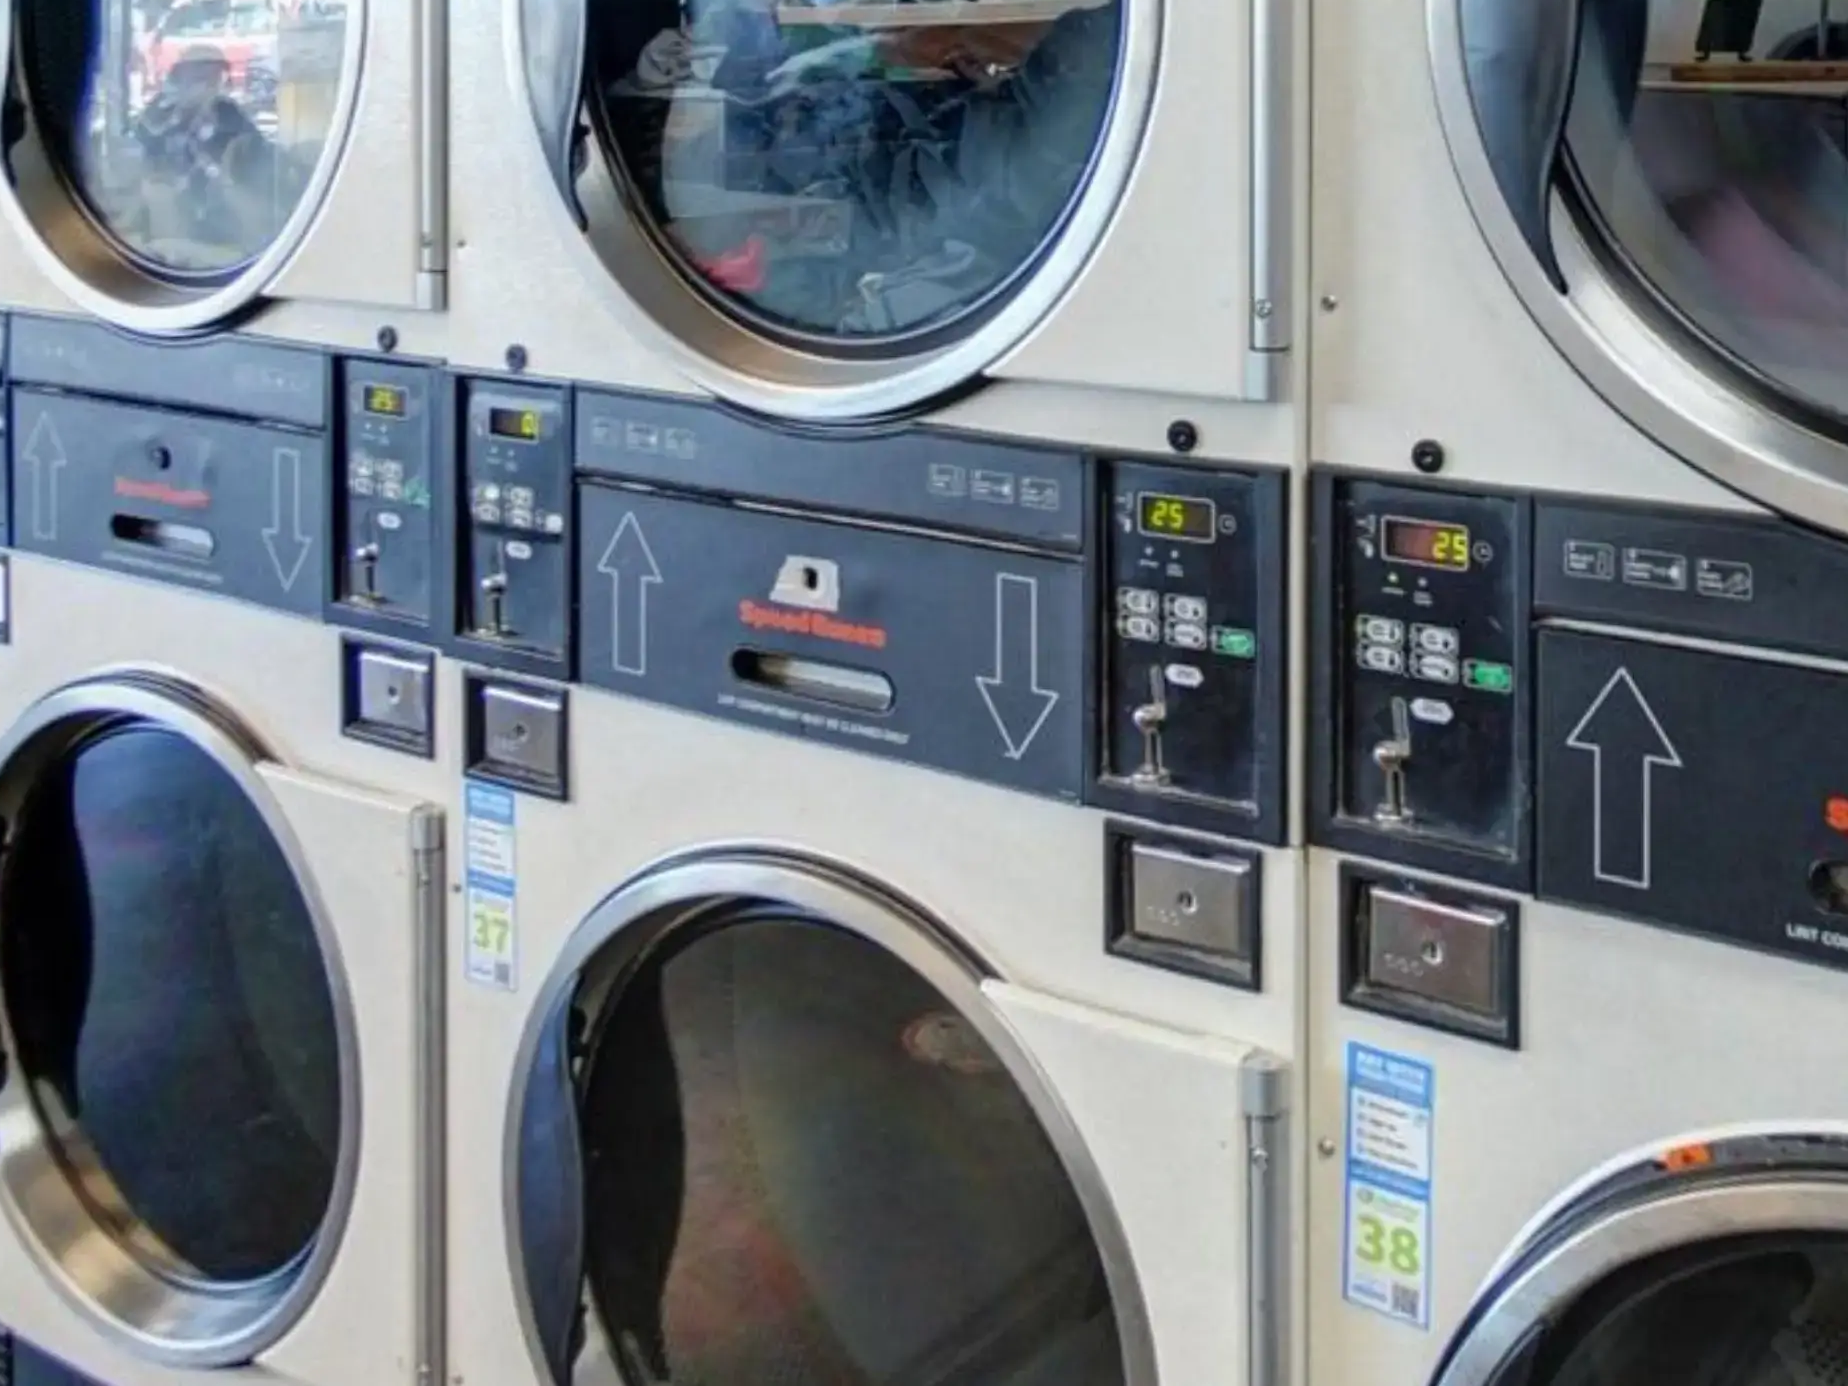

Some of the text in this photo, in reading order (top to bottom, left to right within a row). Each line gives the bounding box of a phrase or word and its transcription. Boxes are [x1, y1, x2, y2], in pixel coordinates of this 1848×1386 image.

[1152, 501, 1184, 528] 25
[1432, 531, 1468, 562] 25
[473, 911, 509, 952] 37
[1356, 1214, 1419, 1276] 38
